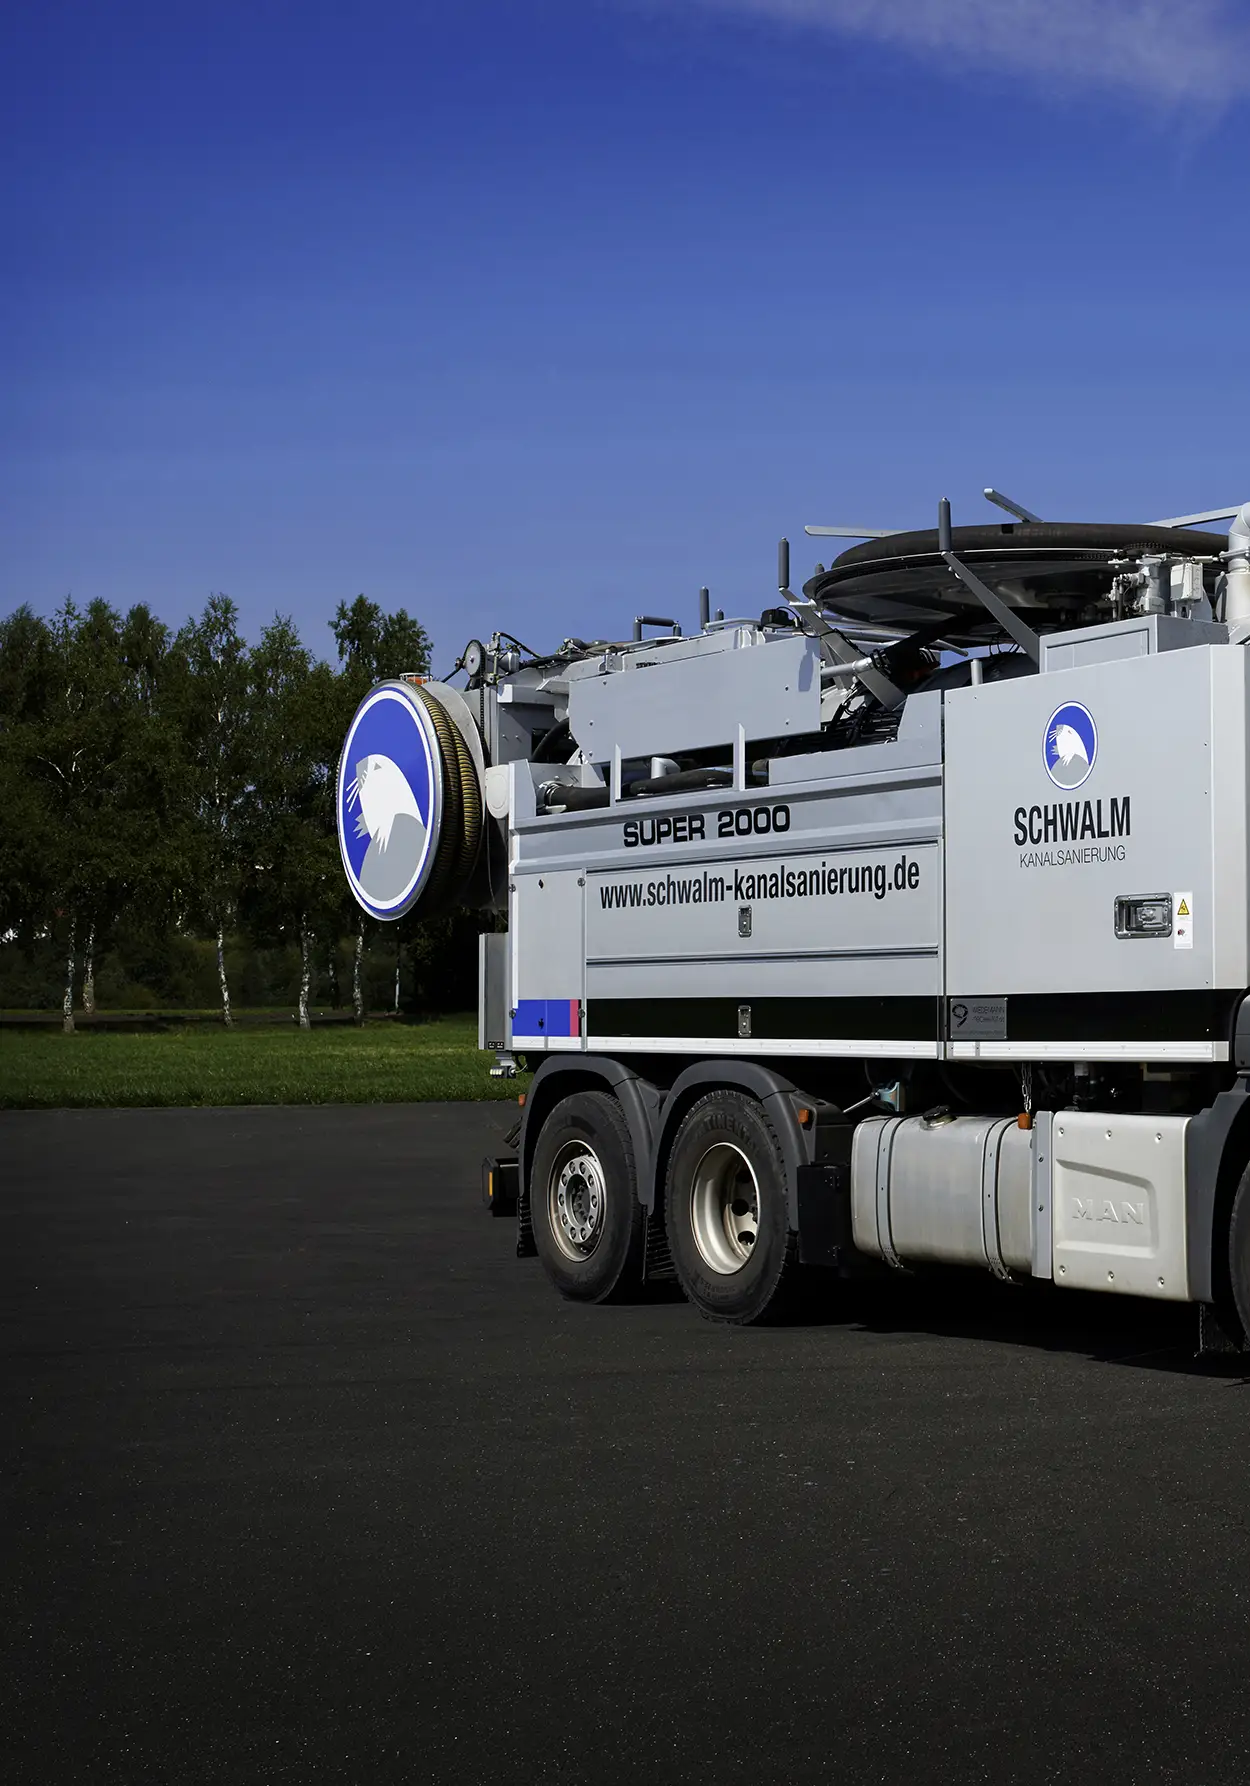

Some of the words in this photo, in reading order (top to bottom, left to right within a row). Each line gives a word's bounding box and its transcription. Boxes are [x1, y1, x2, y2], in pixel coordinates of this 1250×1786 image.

[623, 813, 705, 847] SUPER
[717, 804, 790, 838] 2000
[1014, 796, 1130, 846] SCHWALM
[1020, 845, 1125, 868] KANALSANIERUNG
[600, 855, 920, 909] www.schwalm-kanalsanierung.de
[1072, 1198, 1144, 1225] MAN
